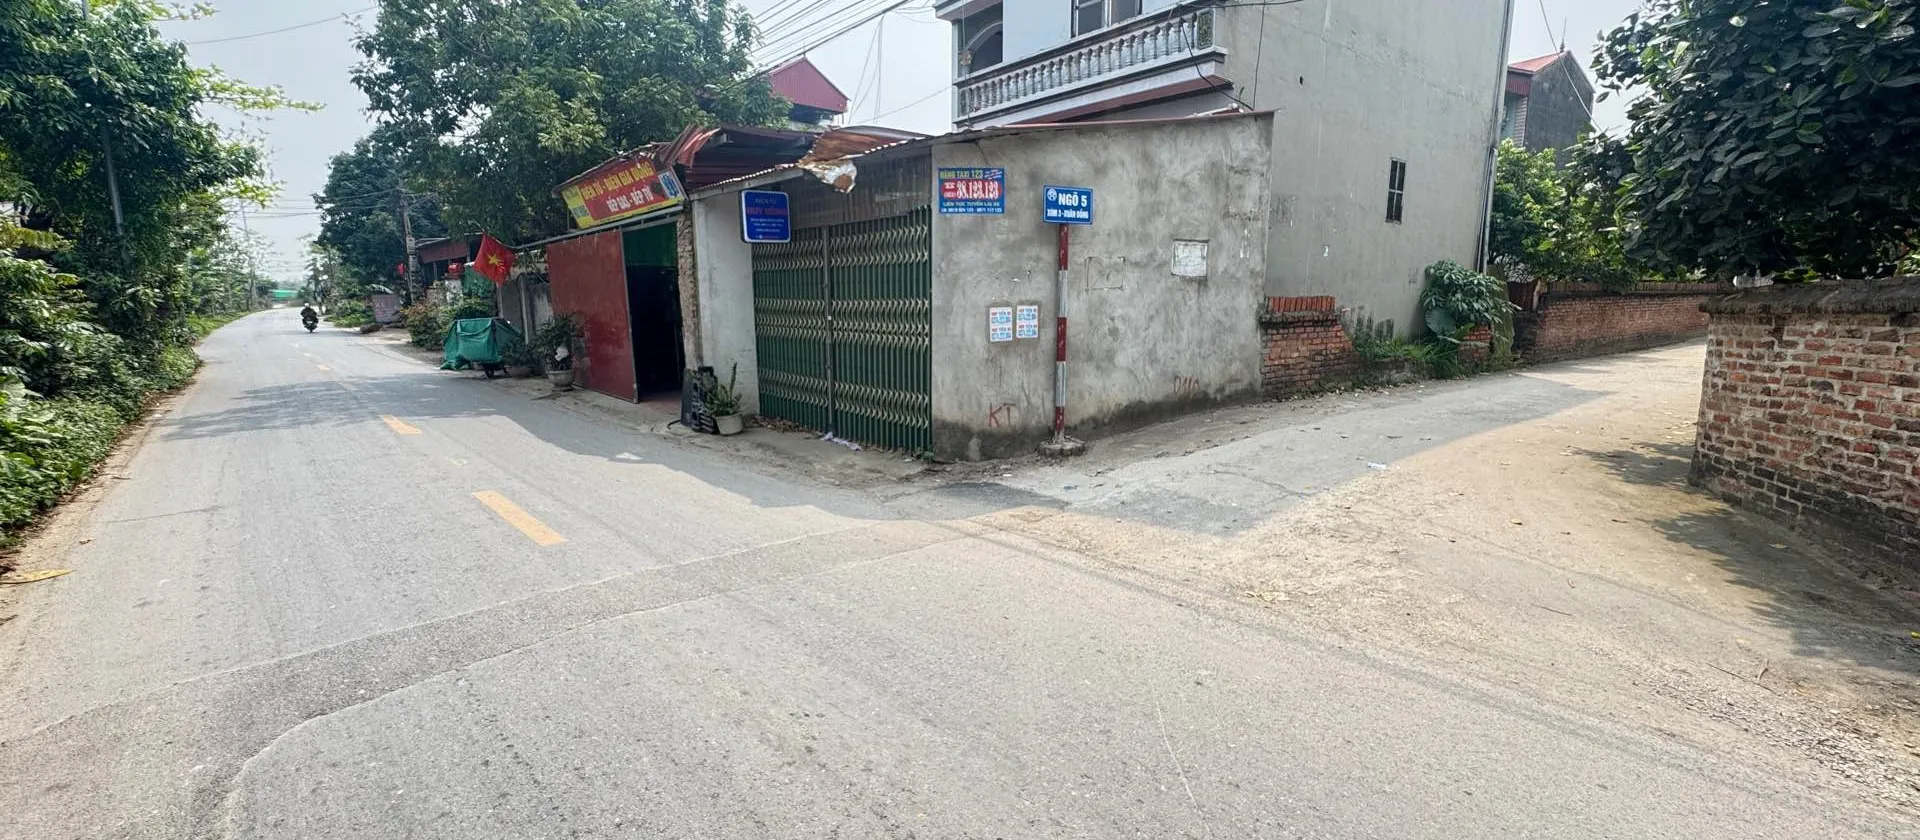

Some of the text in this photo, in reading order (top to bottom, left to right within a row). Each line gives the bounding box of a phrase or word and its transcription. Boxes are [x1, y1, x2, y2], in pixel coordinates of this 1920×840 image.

[618, 170, 633, 186] GIA
[956, 170, 969, 179] TAXI
[971, 169, 983, 179] 123
[1058, 191, 1087, 207] NGÕ 5
